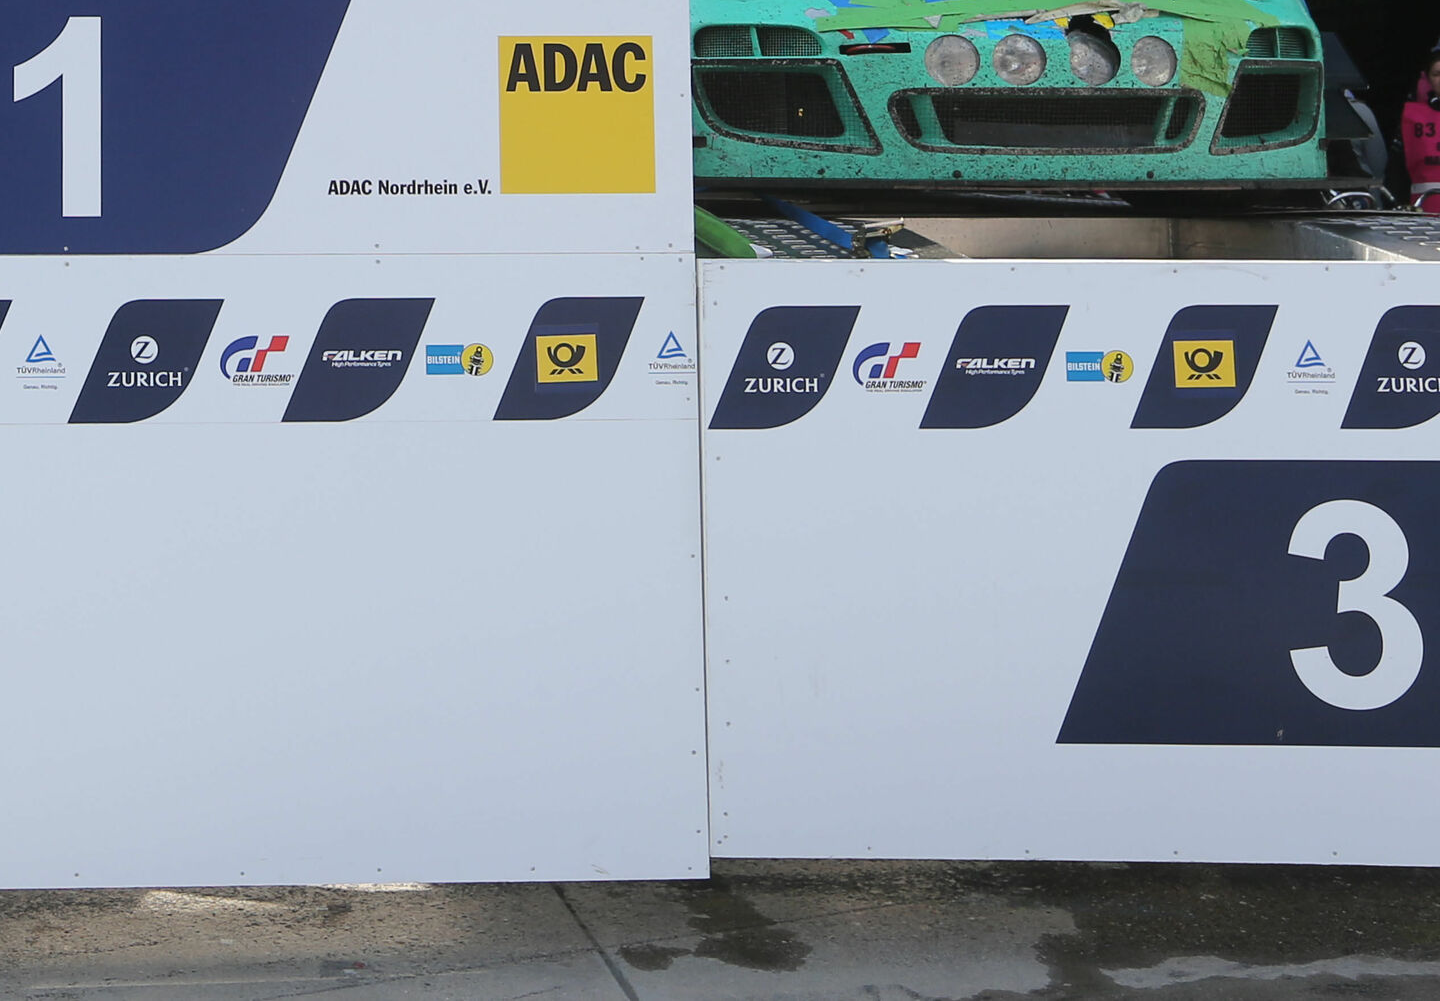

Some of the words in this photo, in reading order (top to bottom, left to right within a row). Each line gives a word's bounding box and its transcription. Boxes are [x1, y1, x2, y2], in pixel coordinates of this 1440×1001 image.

[505, 42, 647, 92] ADAC
[13, 16, 101, 218] 1
[328, 180, 373, 195] ADAC
[378, 179, 458, 195] Nordrhein
[464, 179, 492, 195] e.V.
[322, 350, 402, 362] FALKEN
[427, 355, 461, 365] BILSTEIN
[956, 358, 1036, 370] FALKEN
[1067, 362, 1101, 372] BILSTEIN
[107, 371, 182, 387] ZURICH
[232, 374, 256, 383] GRAN
[257, 374, 292, 383] TURISMO
[744, 377, 819, 393] ZURICH
[865, 380, 888, 389] GRAN
[889, 380, 924, 389] TURISMO
[1377, 377, 1440, 393] ZURIC
[1287, 499, 1425, 711] 3
